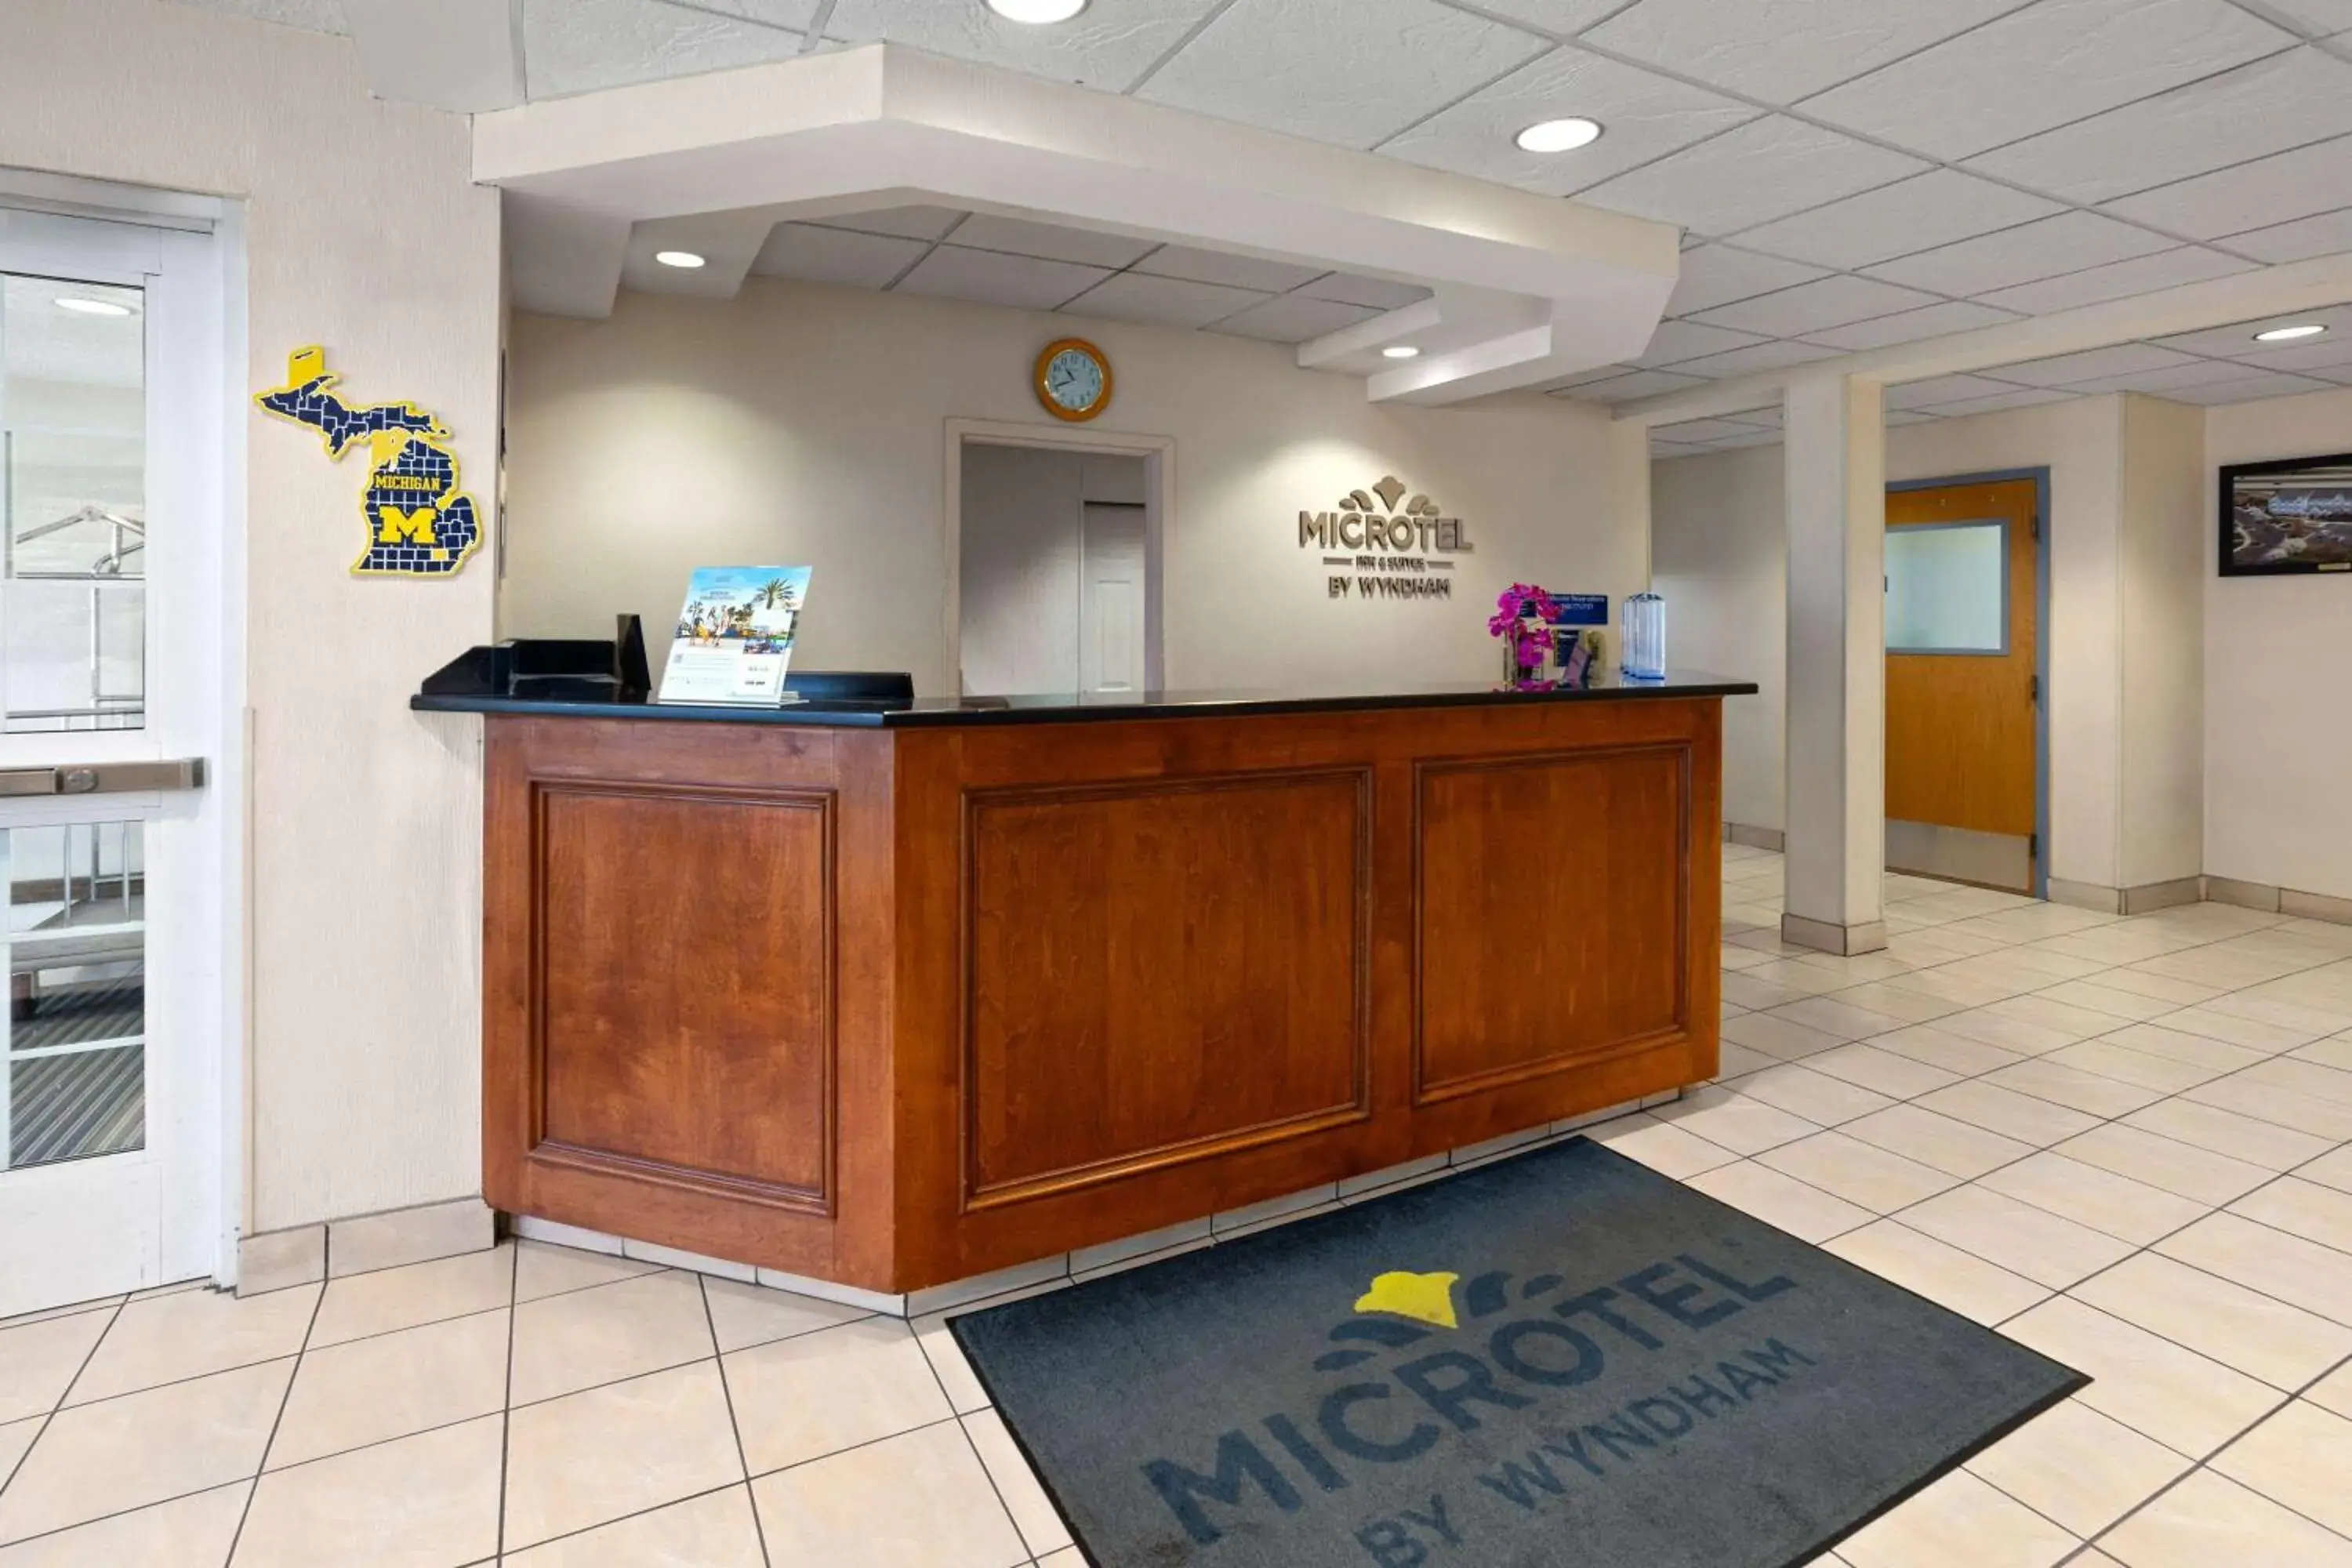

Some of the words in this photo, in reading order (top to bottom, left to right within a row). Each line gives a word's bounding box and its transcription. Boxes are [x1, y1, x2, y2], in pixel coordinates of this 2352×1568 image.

[375, 475, 440, 491] MICHIGAN
[379, 506, 437, 543] M
[1299, 510, 1474, 553] MICROTEL
[1328, 576, 1352, 598] BY
[1357, 576, 1450, 599] WYNDHAM
[1141, 1254, 1799, 1544] MICROTEL
[1352, 1494, 1463, 1568] BY
[1477, 1337, 1817, 1511] WYNDHAM
